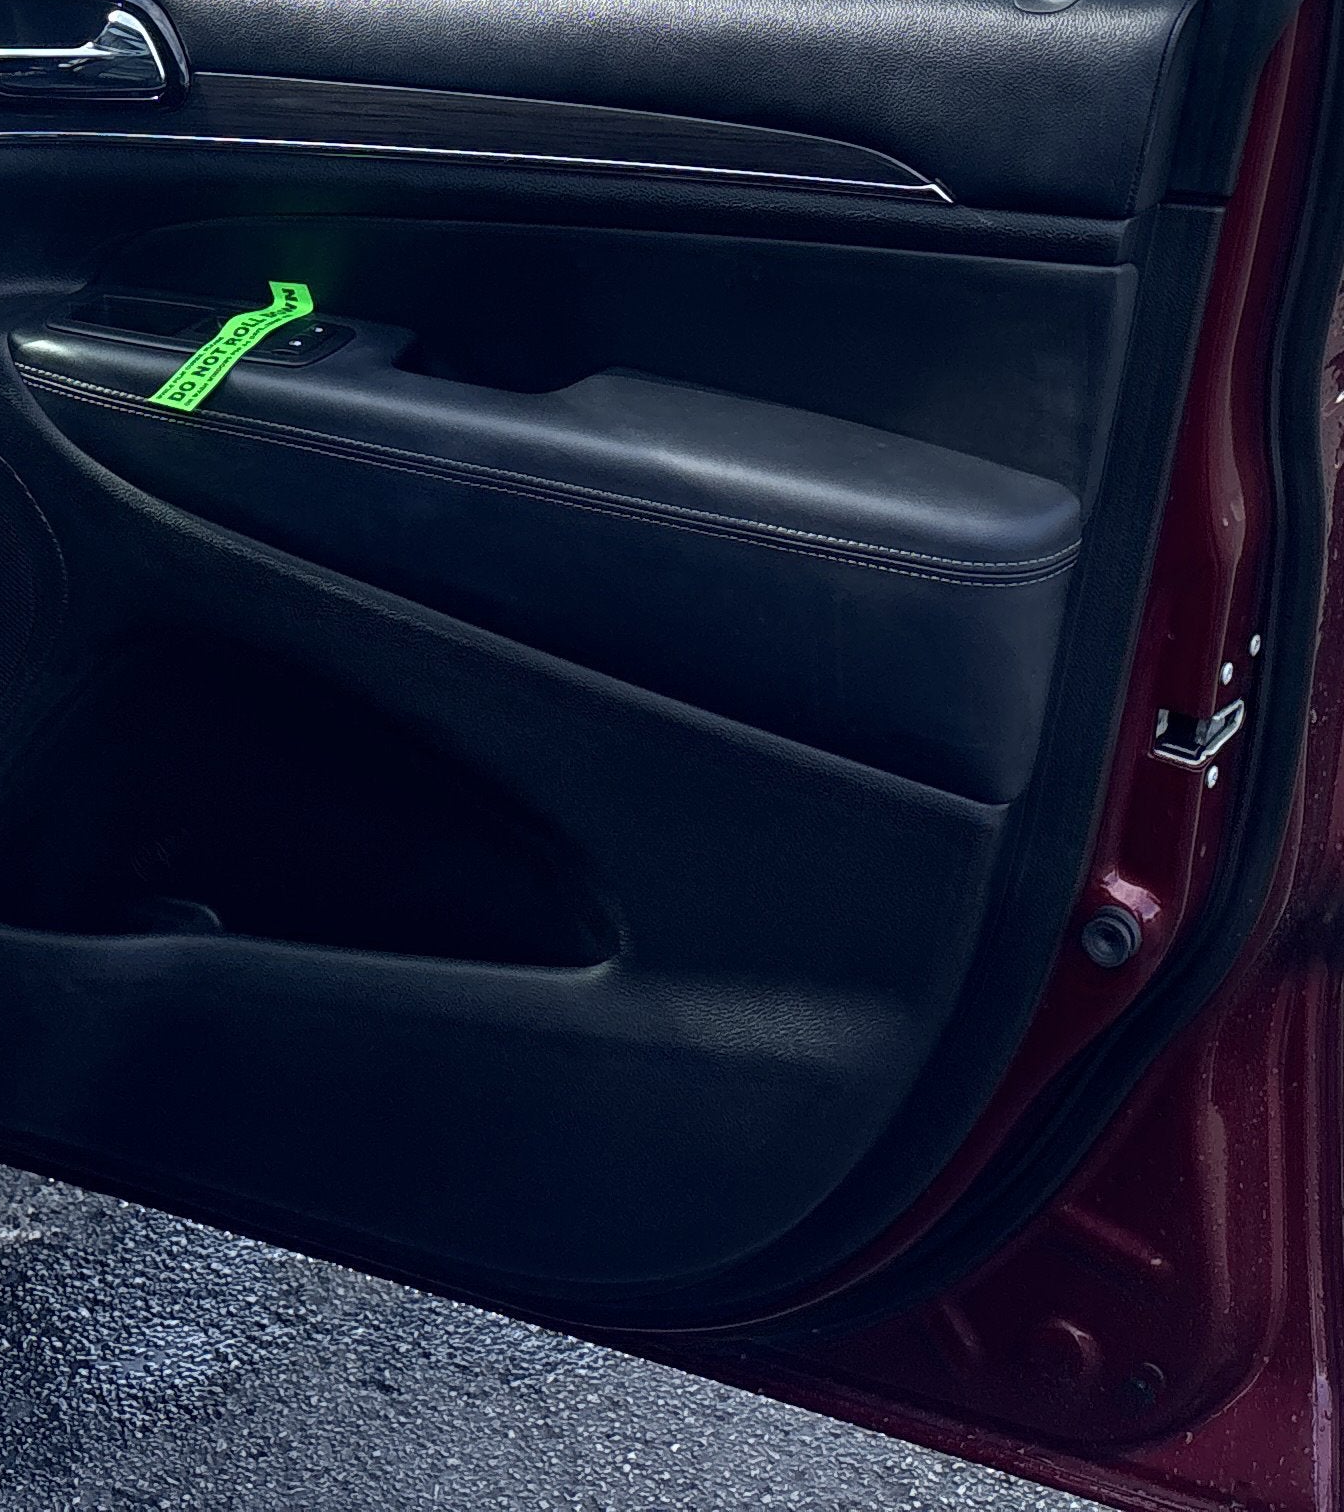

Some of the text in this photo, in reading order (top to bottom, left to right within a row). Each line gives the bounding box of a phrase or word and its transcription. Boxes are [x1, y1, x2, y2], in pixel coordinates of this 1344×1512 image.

[167, 381, 196, 402] DO
[191, 347, 227, 377] NOT
[223, 317, 267, 347] ROLL
